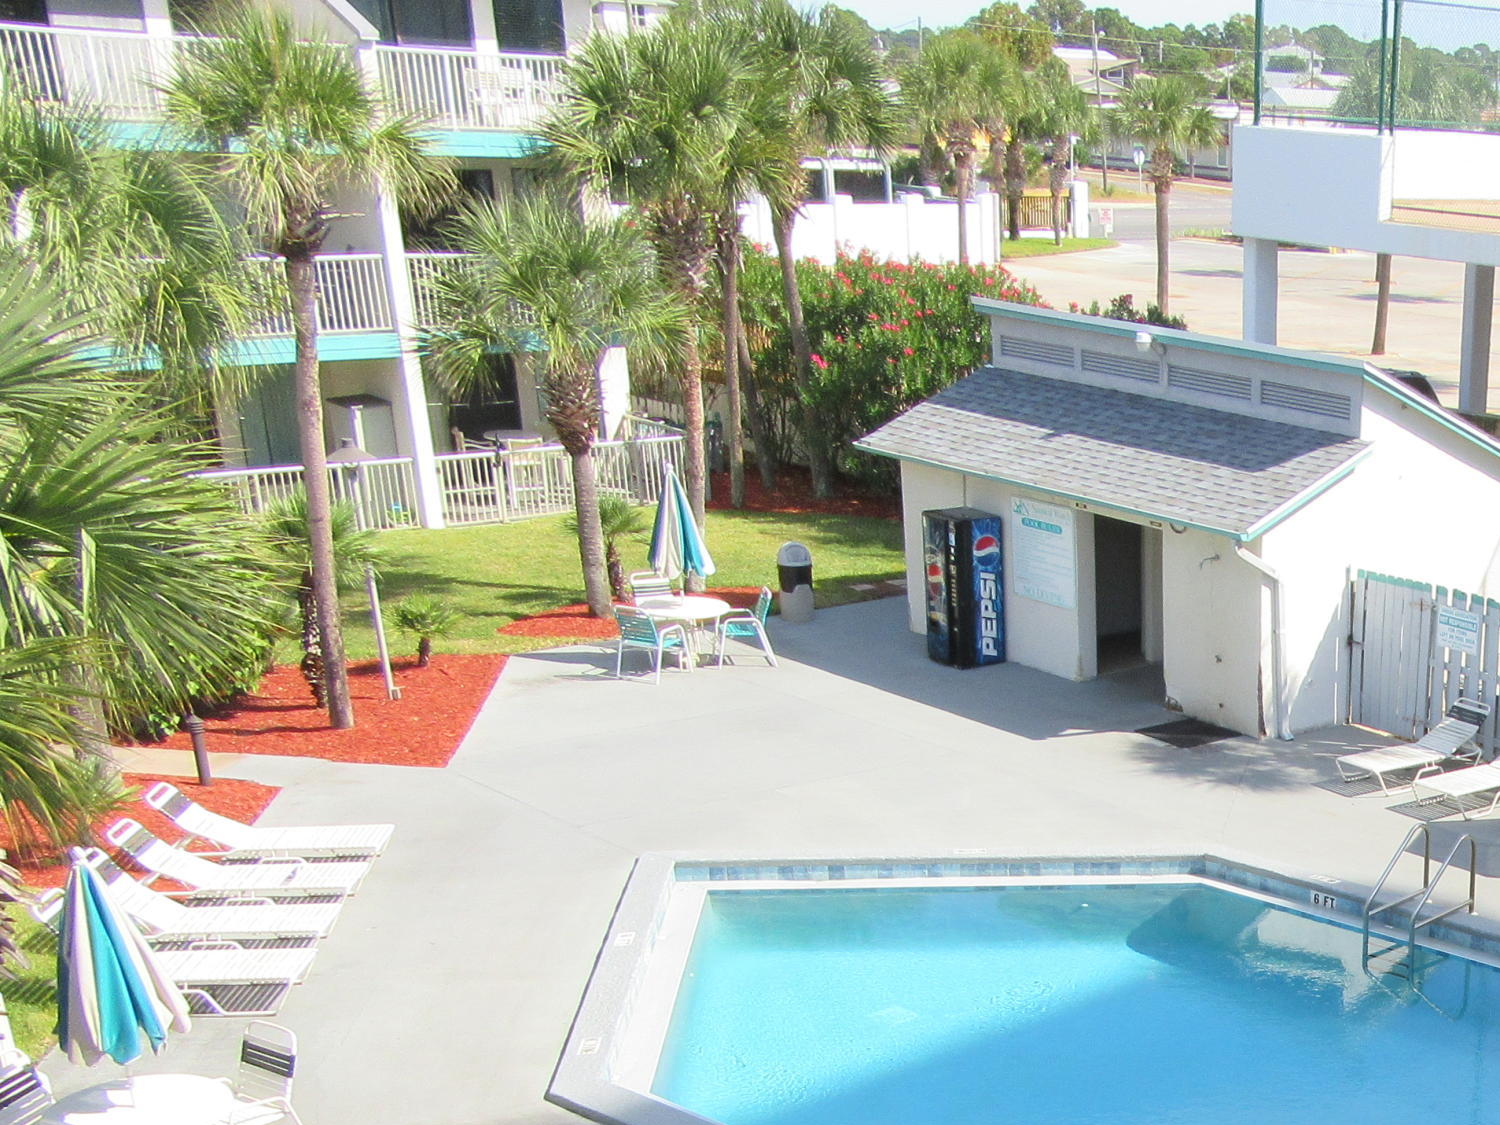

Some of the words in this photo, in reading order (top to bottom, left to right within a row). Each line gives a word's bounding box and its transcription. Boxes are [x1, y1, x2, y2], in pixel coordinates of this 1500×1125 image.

[980, 572, 998, 657] PEPSI
[1313, 893, 1320, 904] 6
[1323, 896, 1335, 908] FT
